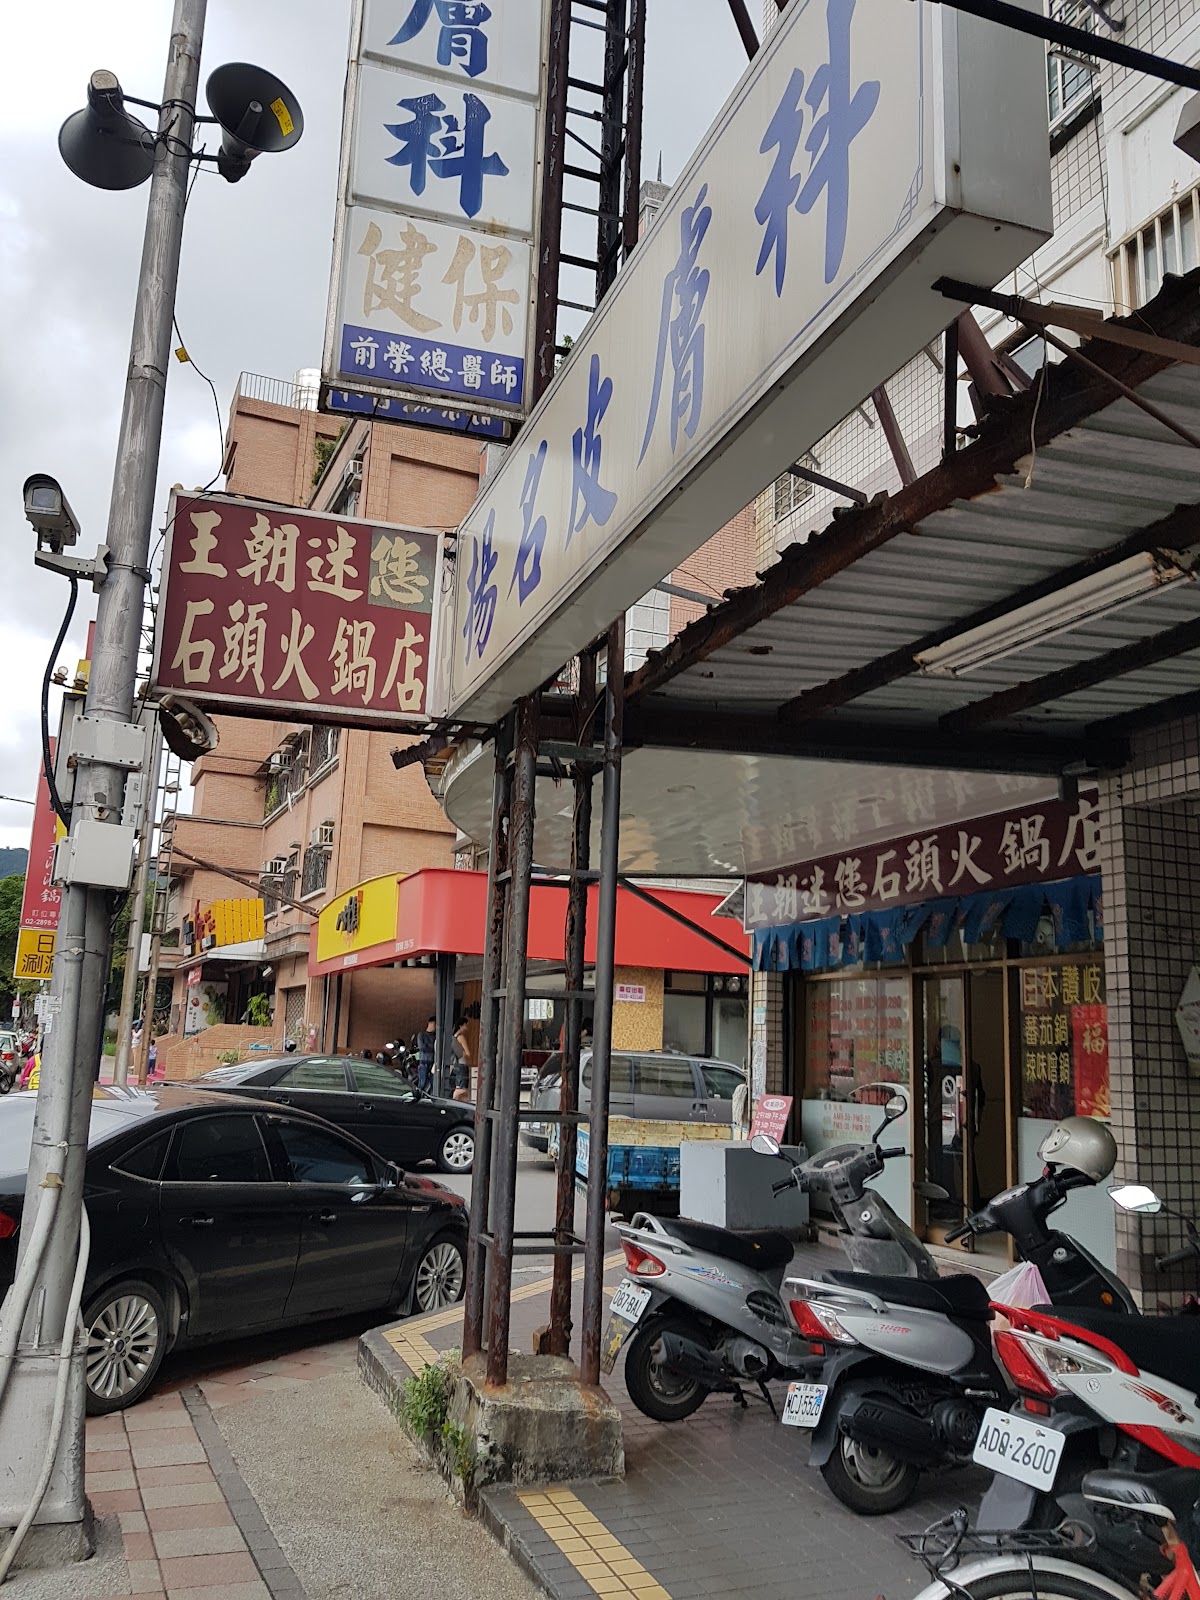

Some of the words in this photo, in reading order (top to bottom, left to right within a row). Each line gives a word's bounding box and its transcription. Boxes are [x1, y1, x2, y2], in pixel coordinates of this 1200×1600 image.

[358, 221, 520, 343] 健保
[350, 335, 519, 395] 前榮總醫師
[170, 598, 425, 712] 石頭火鍋店
[1082, 1021, 1106, 1055] 福
